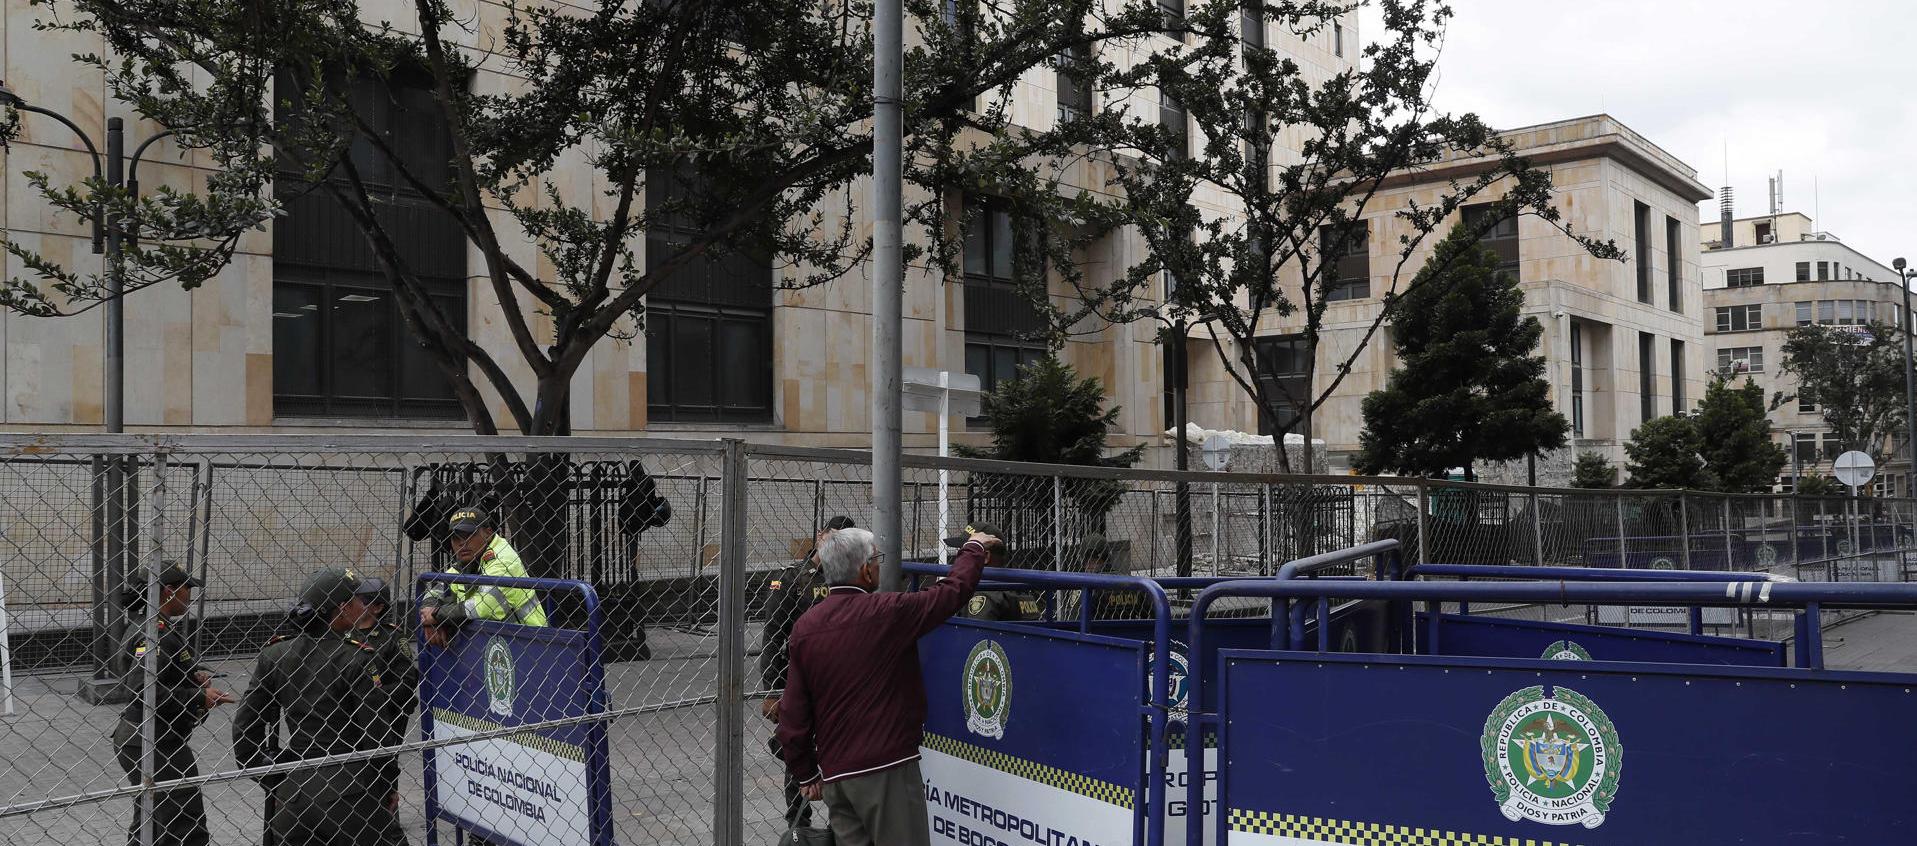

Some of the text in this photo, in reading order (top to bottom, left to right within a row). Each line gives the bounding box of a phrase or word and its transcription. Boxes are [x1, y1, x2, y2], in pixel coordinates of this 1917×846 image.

[1499, 701, 1604, 766] REPUBLICA DE COLOMBIA
[455, 752, 561, 803] POLICÍA NACIONAL
[1505, 772, 1600, 808] POLICIA NACIONAL
[468, 780, 546, 823] DE COLOMBIA
[1516, 801, 1540, 818] DIOS
[1552, 808, 1588, 821] PATRIA
[934, 815, 956, 840] DE
